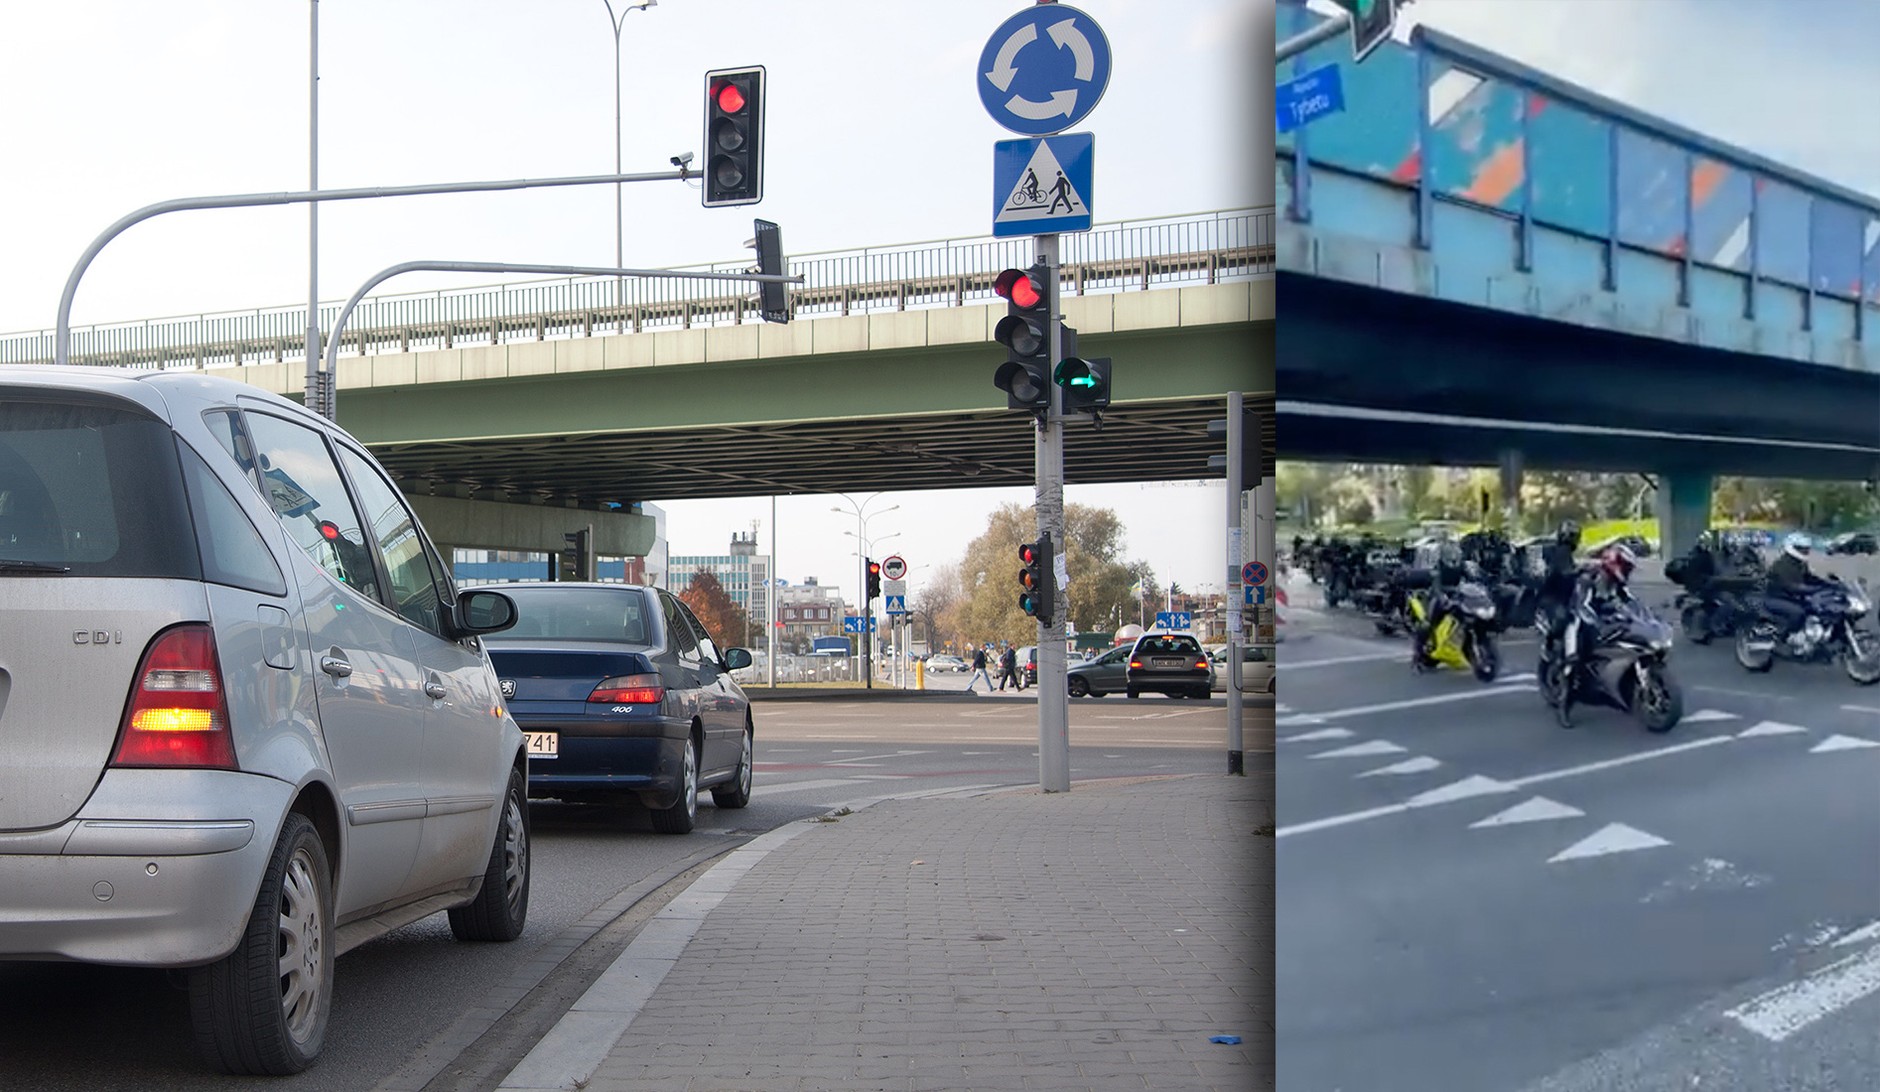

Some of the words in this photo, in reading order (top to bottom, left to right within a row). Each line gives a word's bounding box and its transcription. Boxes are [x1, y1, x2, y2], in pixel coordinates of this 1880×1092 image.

[1287, 94, 1330, 123] Tybetu
[73, 628, 122, 644] CDI
[611, 705, 633, 713] 406
